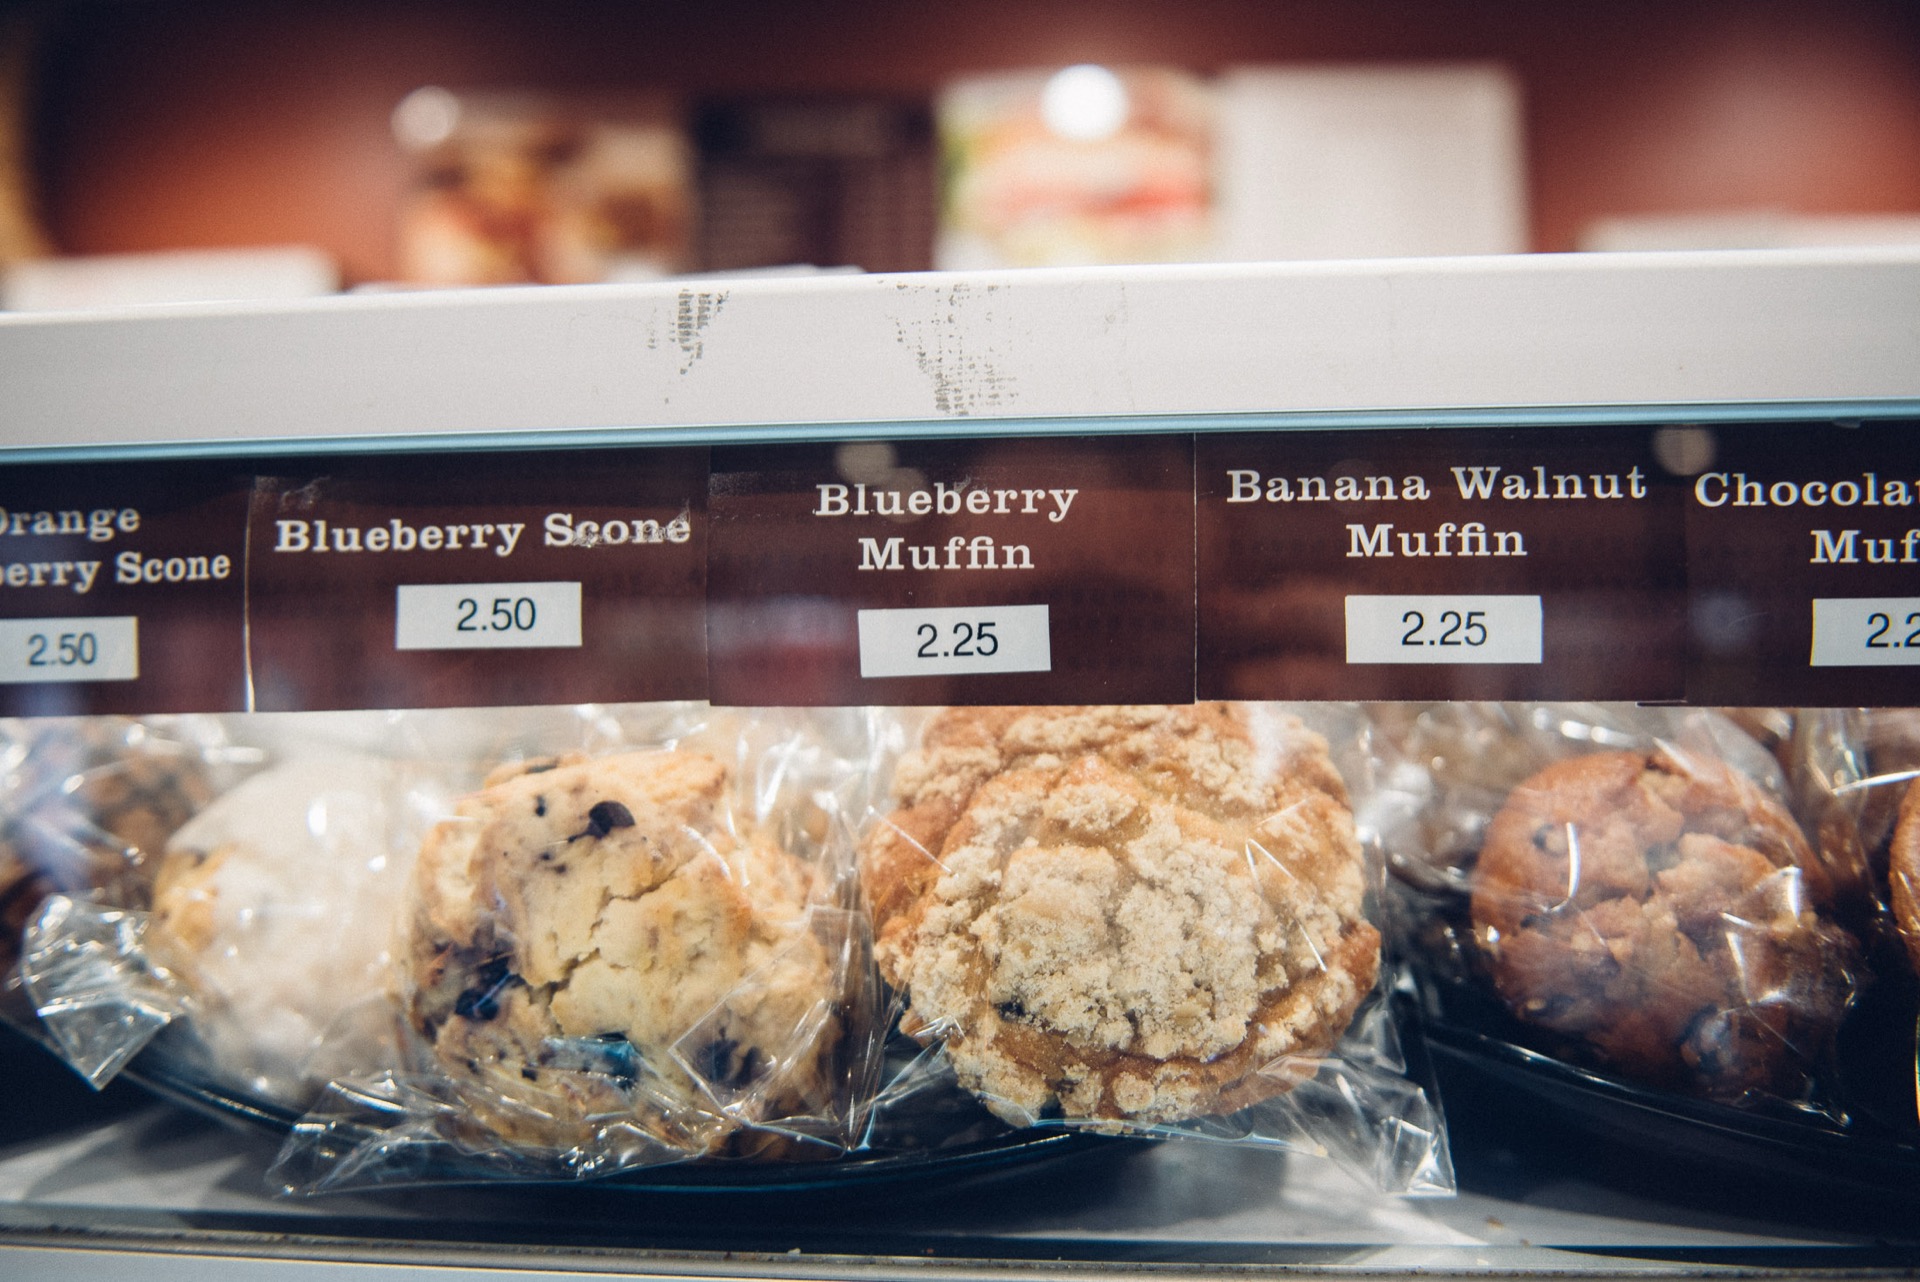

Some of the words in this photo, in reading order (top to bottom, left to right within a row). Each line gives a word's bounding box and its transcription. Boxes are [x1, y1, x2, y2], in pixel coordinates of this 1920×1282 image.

[1226, 468, 1431, 502] Banana
[1451, 465, 1647, 500] Walnut
[815, 483, 1079, 523] Blueberry
[274, 518, 526, 557] Blueberry
[544, 511, 692, 548] Scone
[1346, 523, 1528, 558] Muffin
[857, 537, 1036, 571] Muffin
[0, 560, 101, 594] erry
[115, 551, 232, 584] Scone
[456, 598, 537, 632] 2.50
[1401, 611, 1488, 647] 2.25
[27, 632, 98, 667] 2.50
[916, 622, 1000, 659] 2.25
